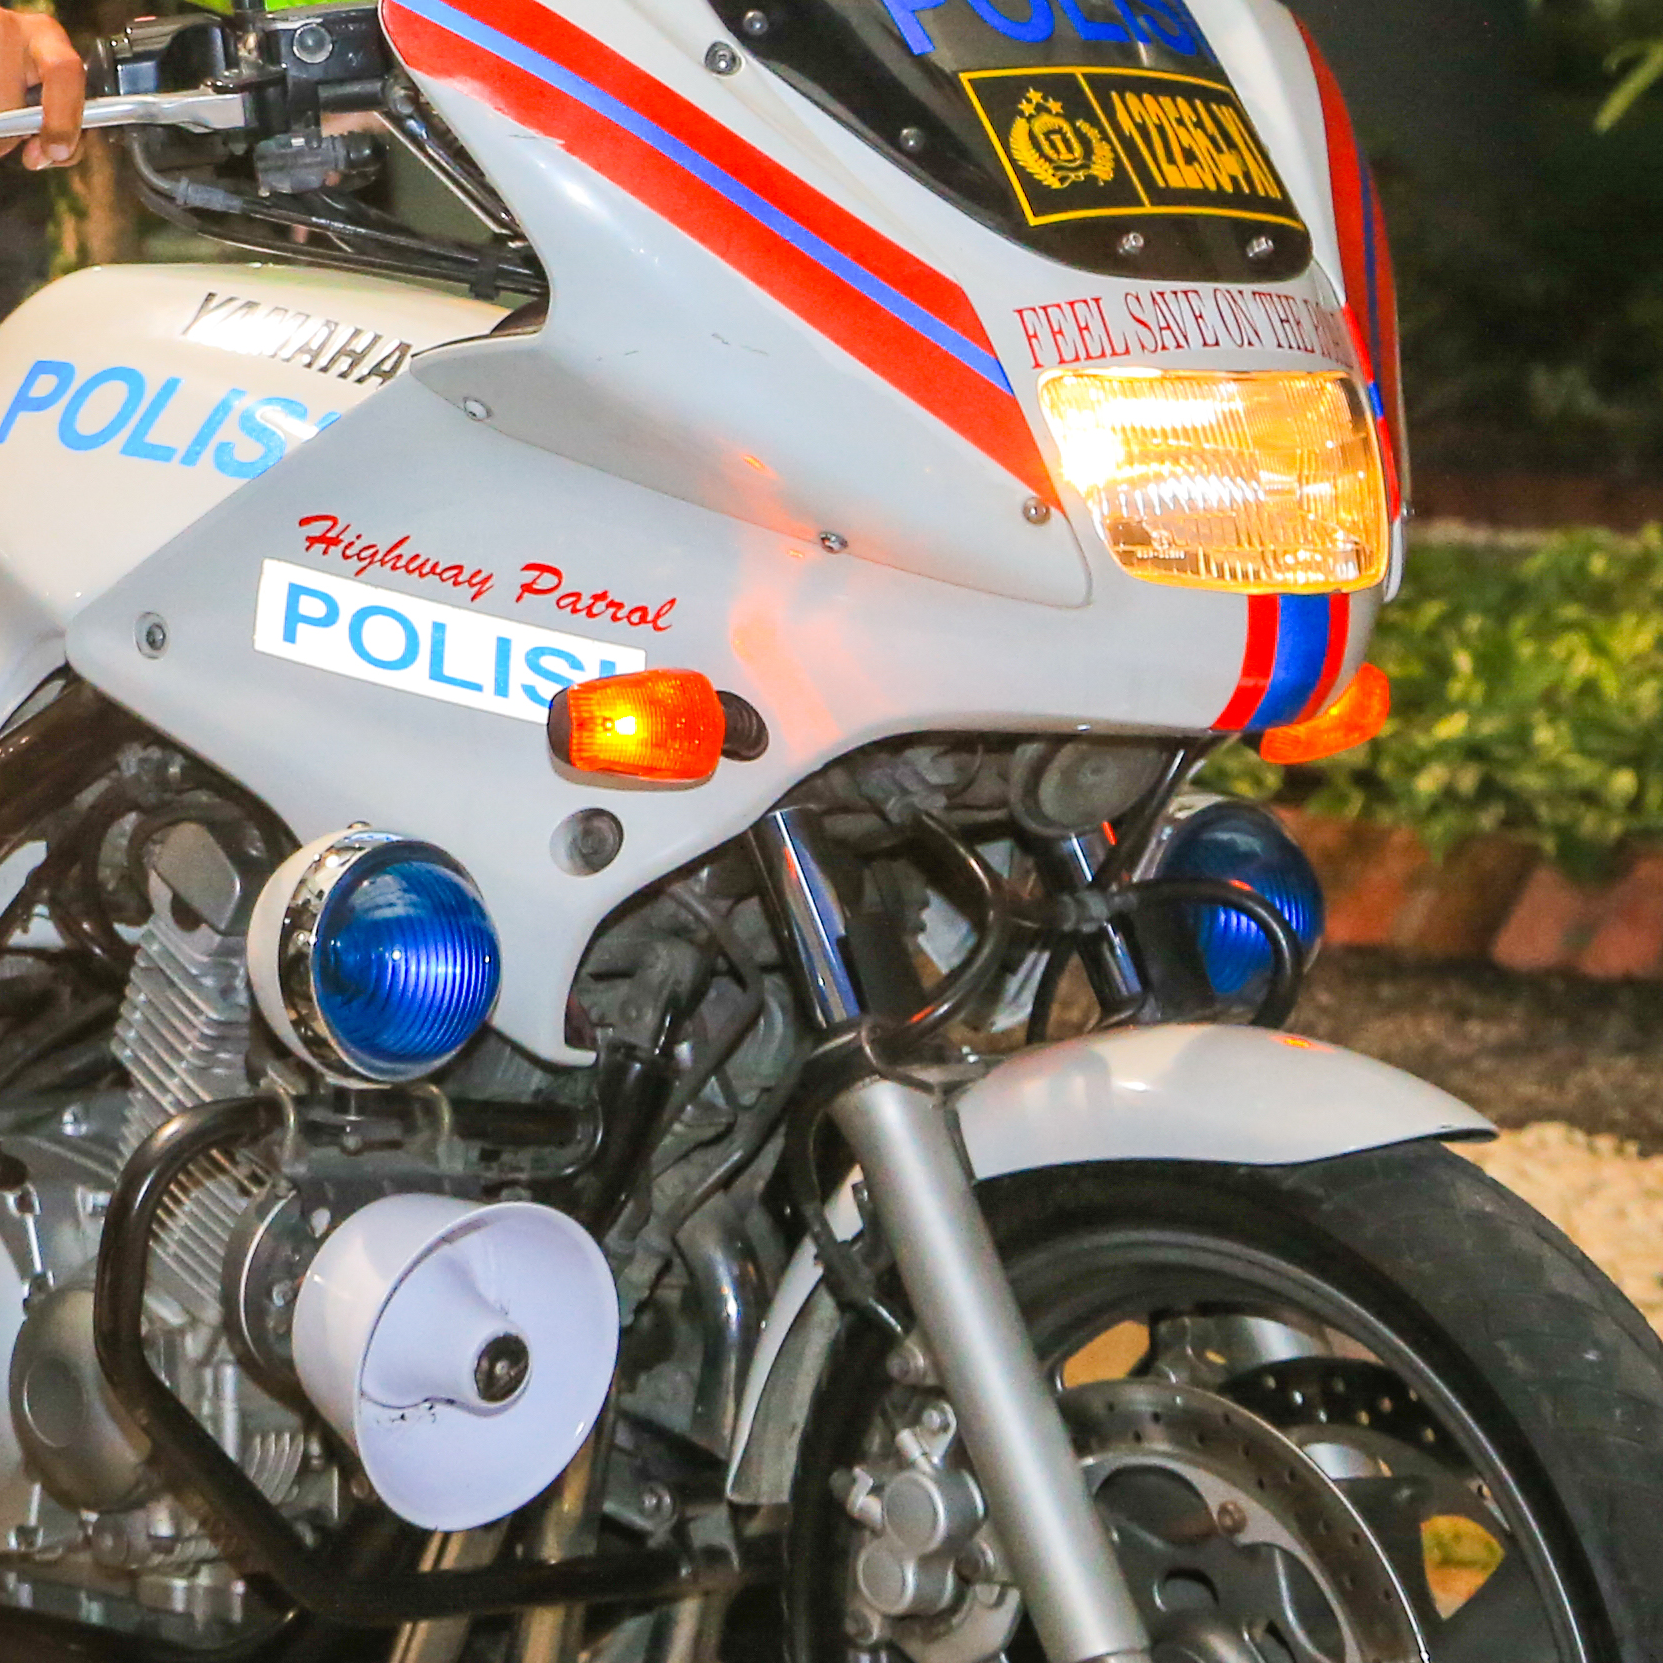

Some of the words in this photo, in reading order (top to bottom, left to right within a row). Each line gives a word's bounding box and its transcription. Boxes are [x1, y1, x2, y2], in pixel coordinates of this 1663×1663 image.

[1013, 297, 1131, 369] FEEL
[1125, 289, 1219, 362] SAVE
[1213, 288, 1264, 349] ON
[1253, 291, 1316, 354] THE
[298, 513, 494, 603] Highway
[515, 562, 677, 633] Patrol
